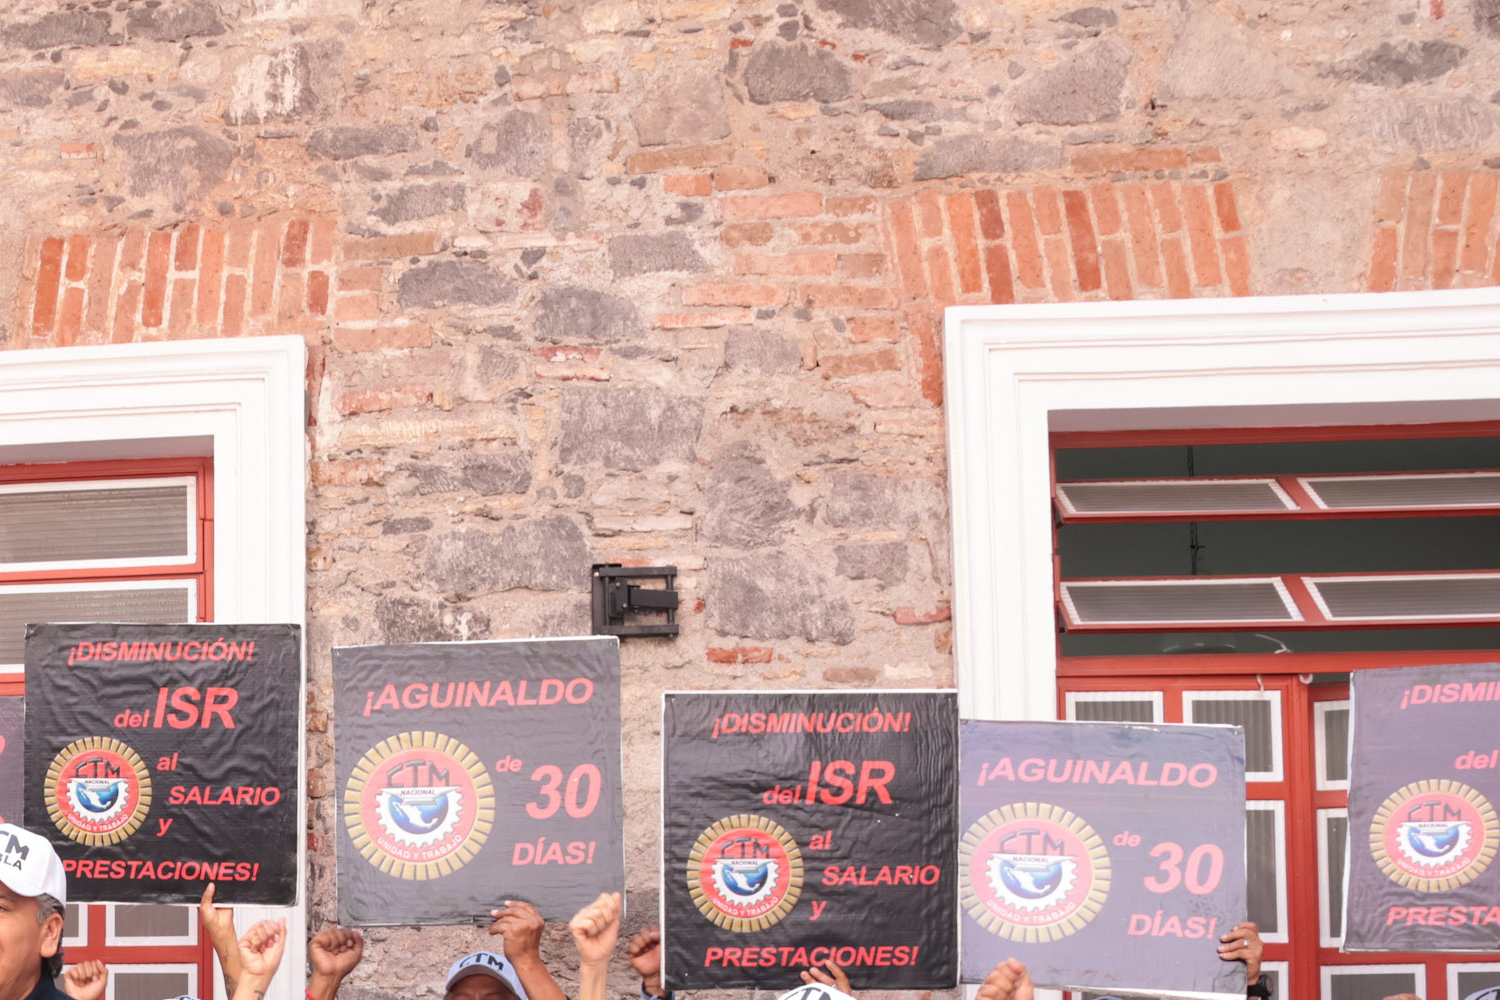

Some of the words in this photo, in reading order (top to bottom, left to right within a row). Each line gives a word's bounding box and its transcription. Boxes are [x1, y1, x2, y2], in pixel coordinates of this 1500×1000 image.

[68, 637, 255, 665] ¡DISMINUCIÓN!
[114, 709, 151, 728] del
[154, 687, 238, 729] ISR
[364, 677, 594, 717] ¡AGUINALDO
[712, 708, 912, 738] ¡DISMINUCIÓN!
[76, 758, 120, 778] CTM
[156, 752, 179, 771] al
[977, 757, 1218, 788] ¡AGUINALDO
[1455, 749, 1498, 770] del
[388, 760, 450, 788] CTM
[495, 755, 523, 772] de
[526, 763, 602, 819] 30
[763, 785, 802, 805] del
[805, 760, 895, 805] ISR
[169, 786, 281, 806] SALARIO
[1408, 801, 1461, 822] CTM
[156, 818, 173, 837] y
[809, 830, 832, 850] al
[377, 836, 410, 858] UNIDAD
[422, 834, 462, 859] TRABAJO
[512, 837, 596, 866] DÍAS!
[721, 837, 770, 859] CTM
[1000, 829, 1064, 856] CTM
[62, 859, 258, 882] PRESTACIONES!
[822, 865, 940, 886] SALARIO
[1113, 831, 1142, 847] de
[1143, 842, 1224, 895] 30
[809, 901, 827, 920] y
[1128, 910, 1217, 939] DÍAS!
[458, 953, 504, 970] CTM
[704, 946, 919, 973] PRESTACIONES!
